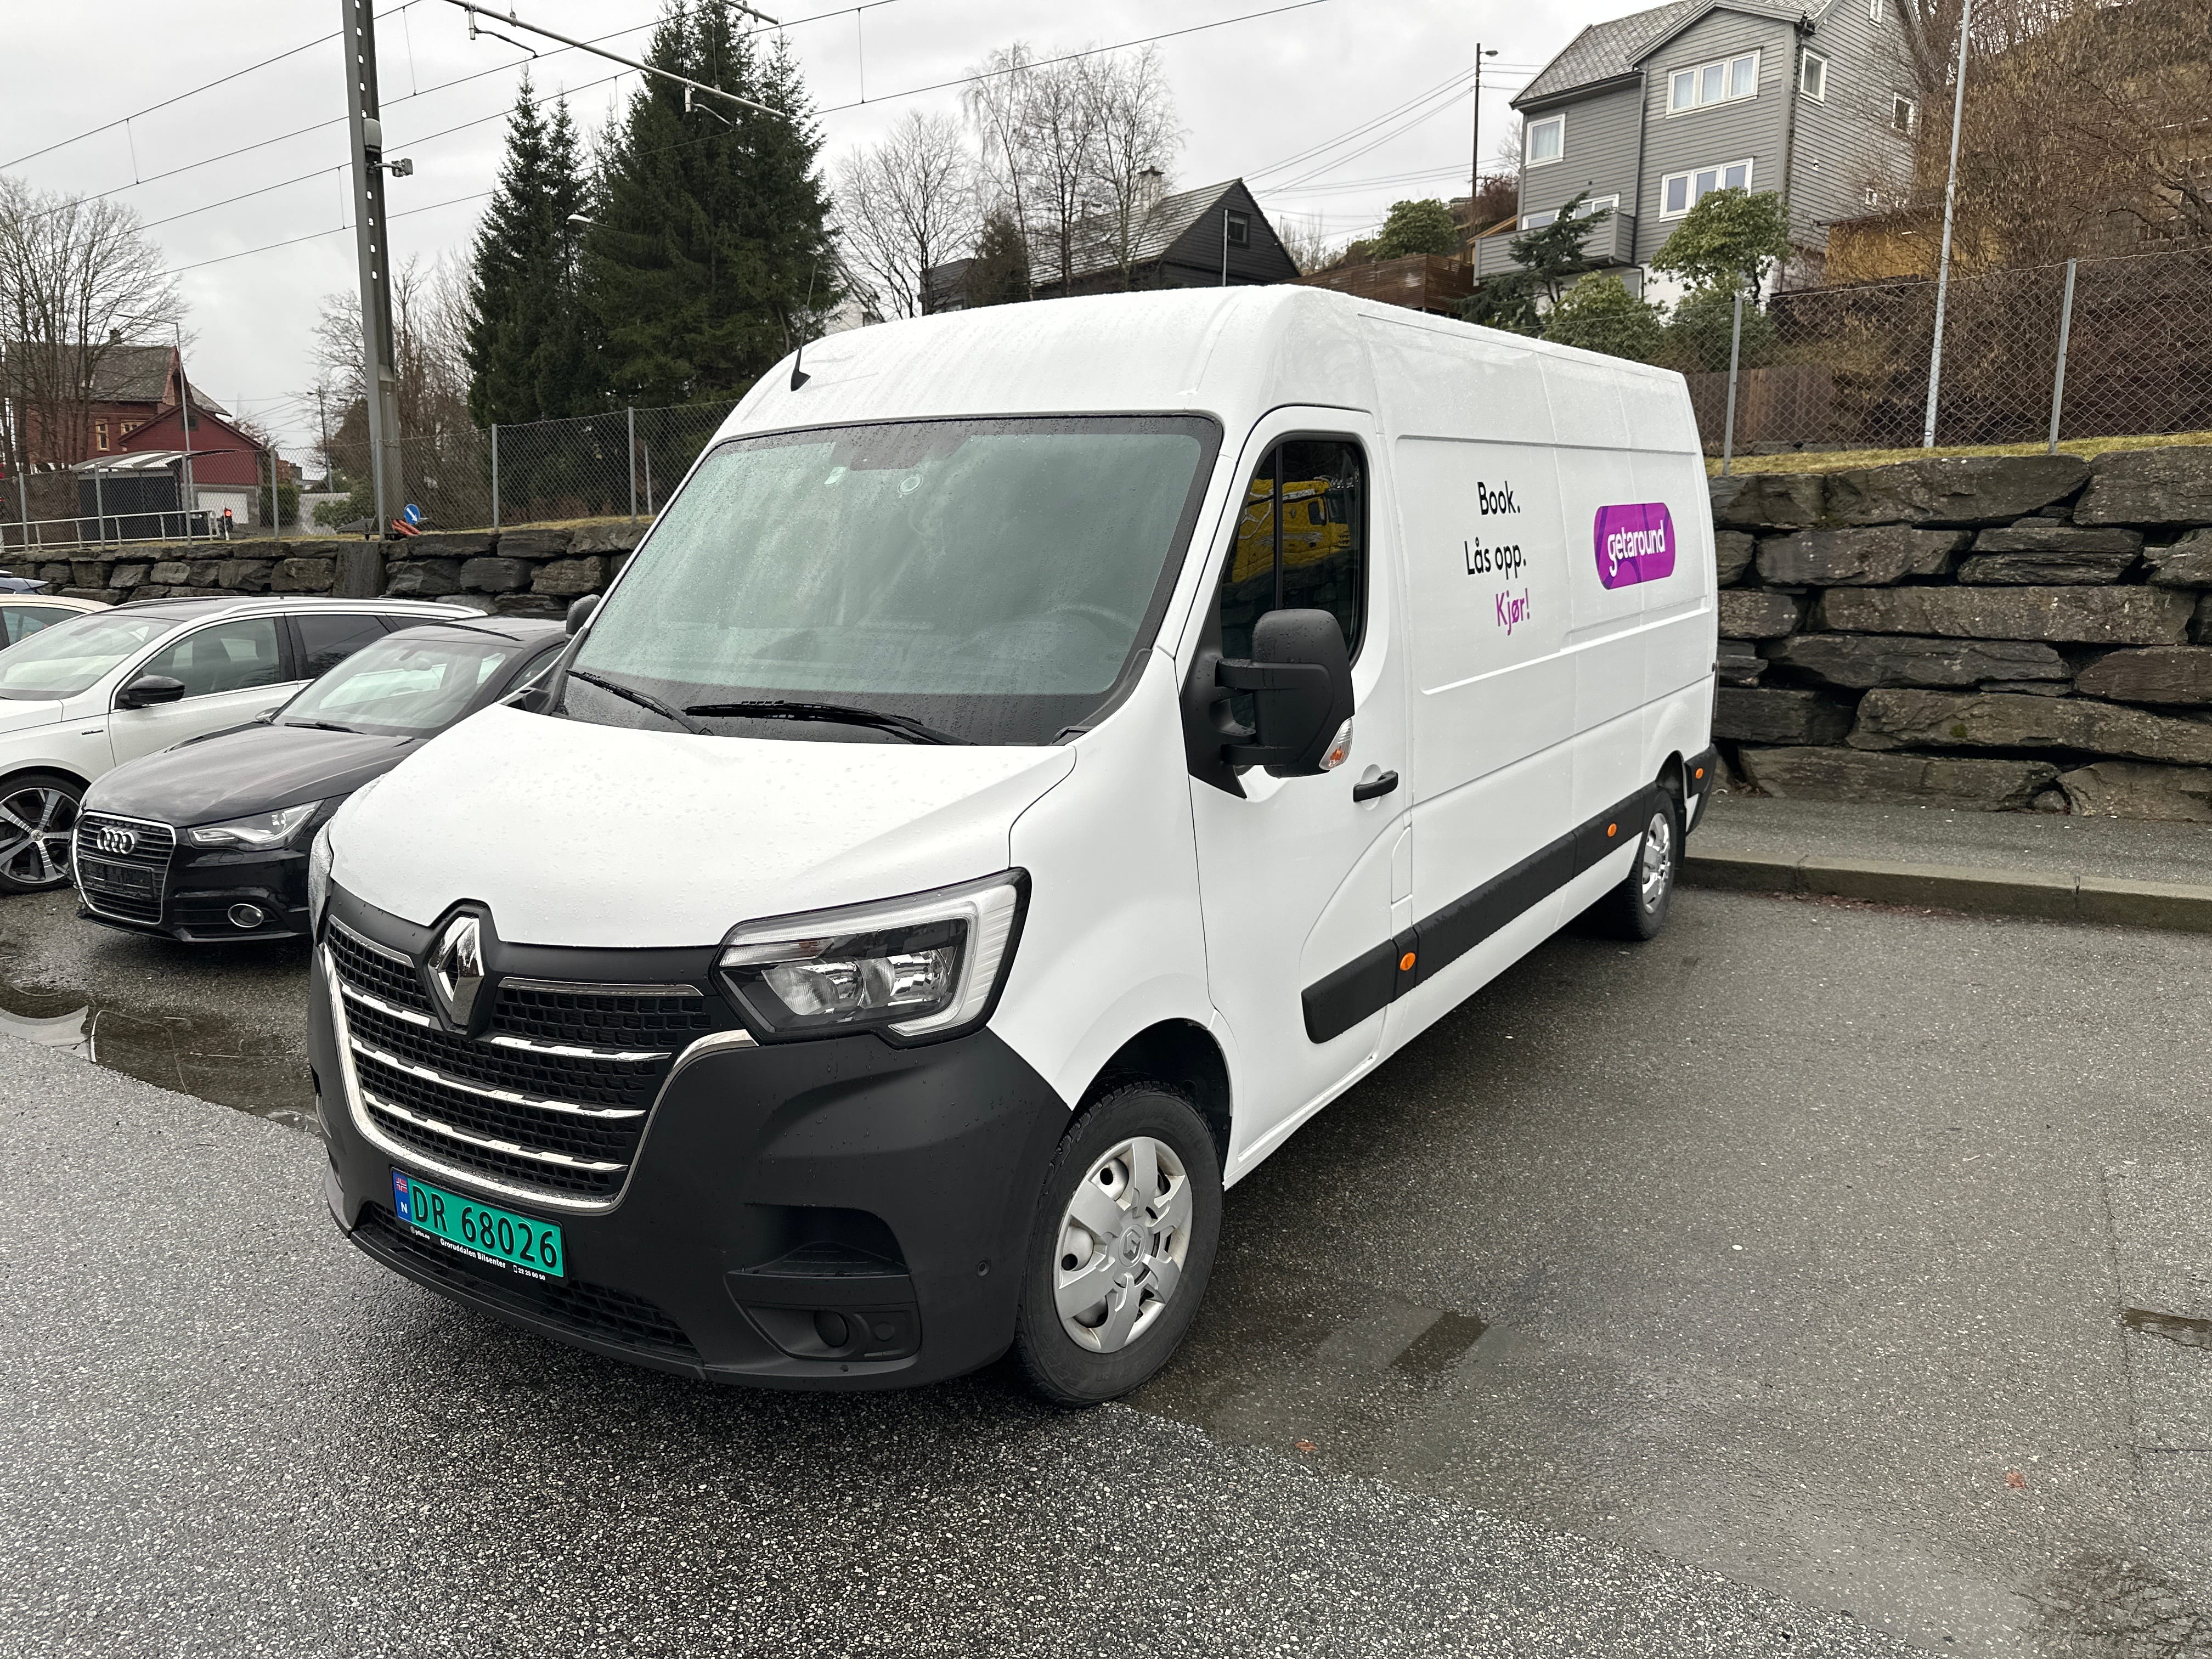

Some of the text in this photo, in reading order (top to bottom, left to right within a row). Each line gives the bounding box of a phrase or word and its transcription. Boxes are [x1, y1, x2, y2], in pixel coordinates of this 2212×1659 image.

[1477, 481, 1521, 516] Book.
[1464, 536, 1526, 580] Lås opp.
[1607, 520, 1666, 577] getaround
[1495, 588, 1531, 636] Kjør!
[400, 1201, 408, 1214] N
[413, 1186, 557, 1268] DR 68026
[440, 1238, 506, 1268] Groruddalen Bilsenter
